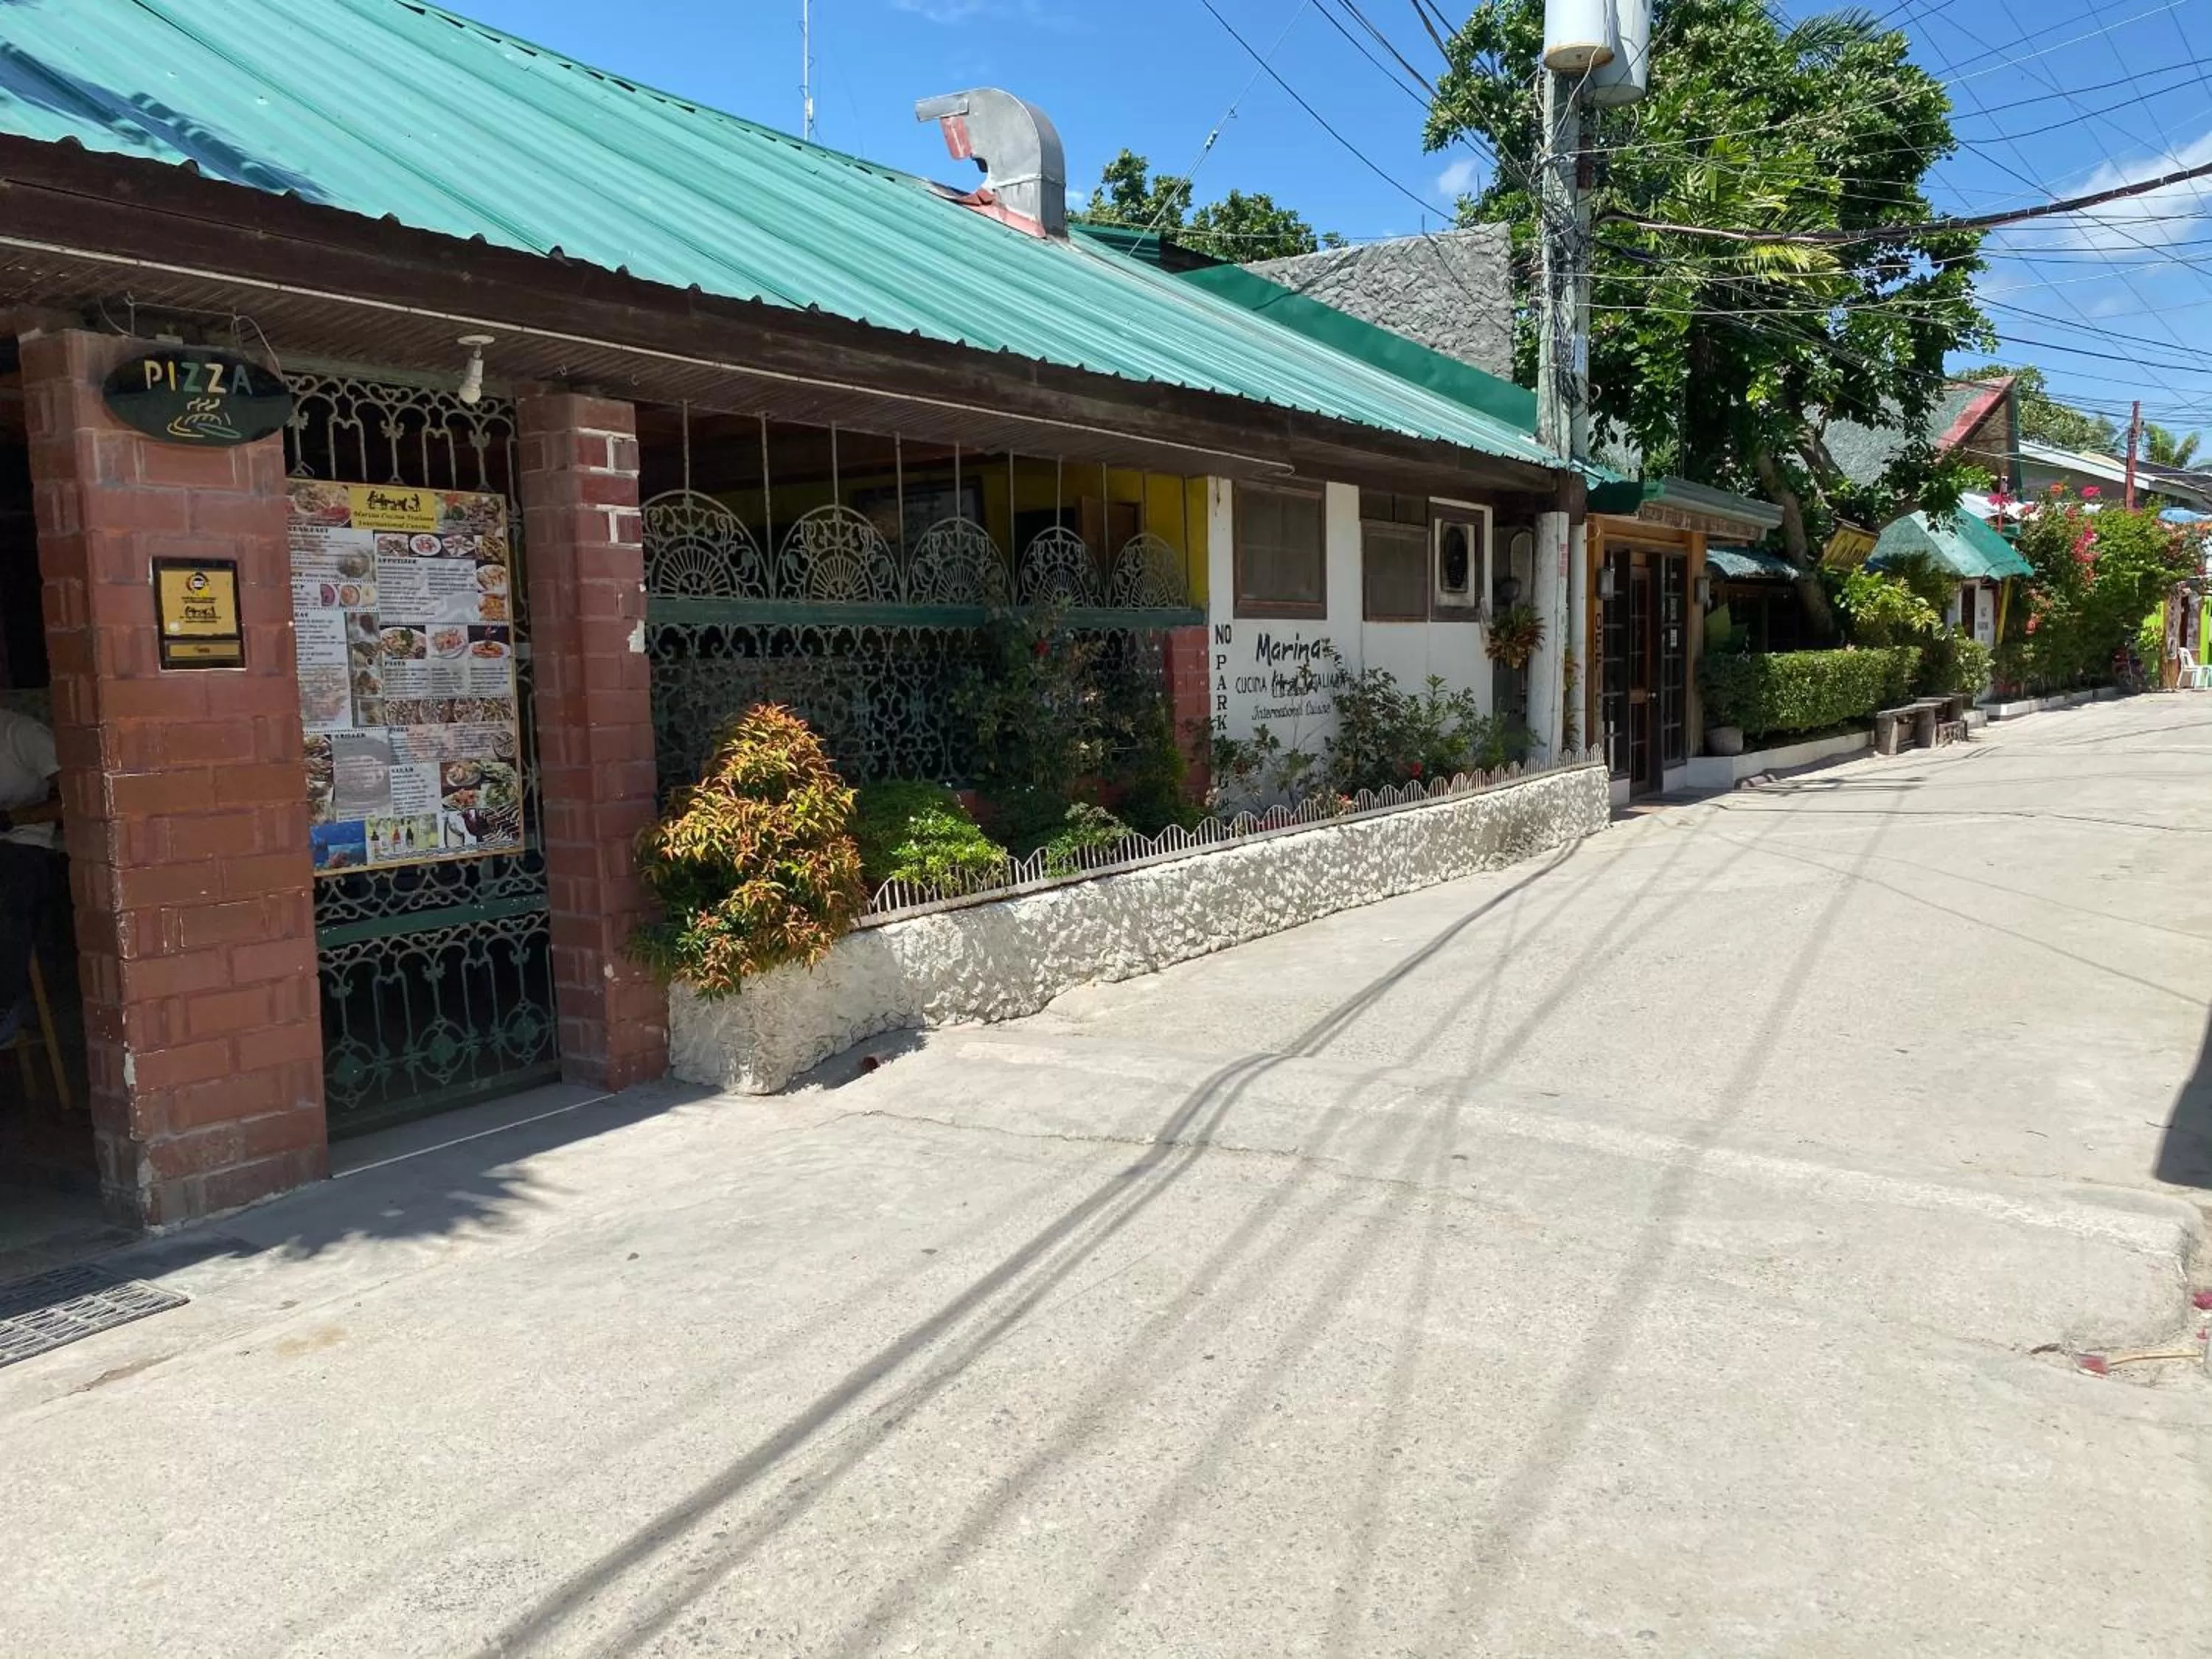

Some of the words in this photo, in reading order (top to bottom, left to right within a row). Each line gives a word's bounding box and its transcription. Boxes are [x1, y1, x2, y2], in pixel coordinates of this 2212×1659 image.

[144, 358, 254, 396] PIZZA
[1215, 624, 1232, 644] NO
[1255, 631, 1321, 667] Marina
[1235, 675, 1267, 694] CUCINA
